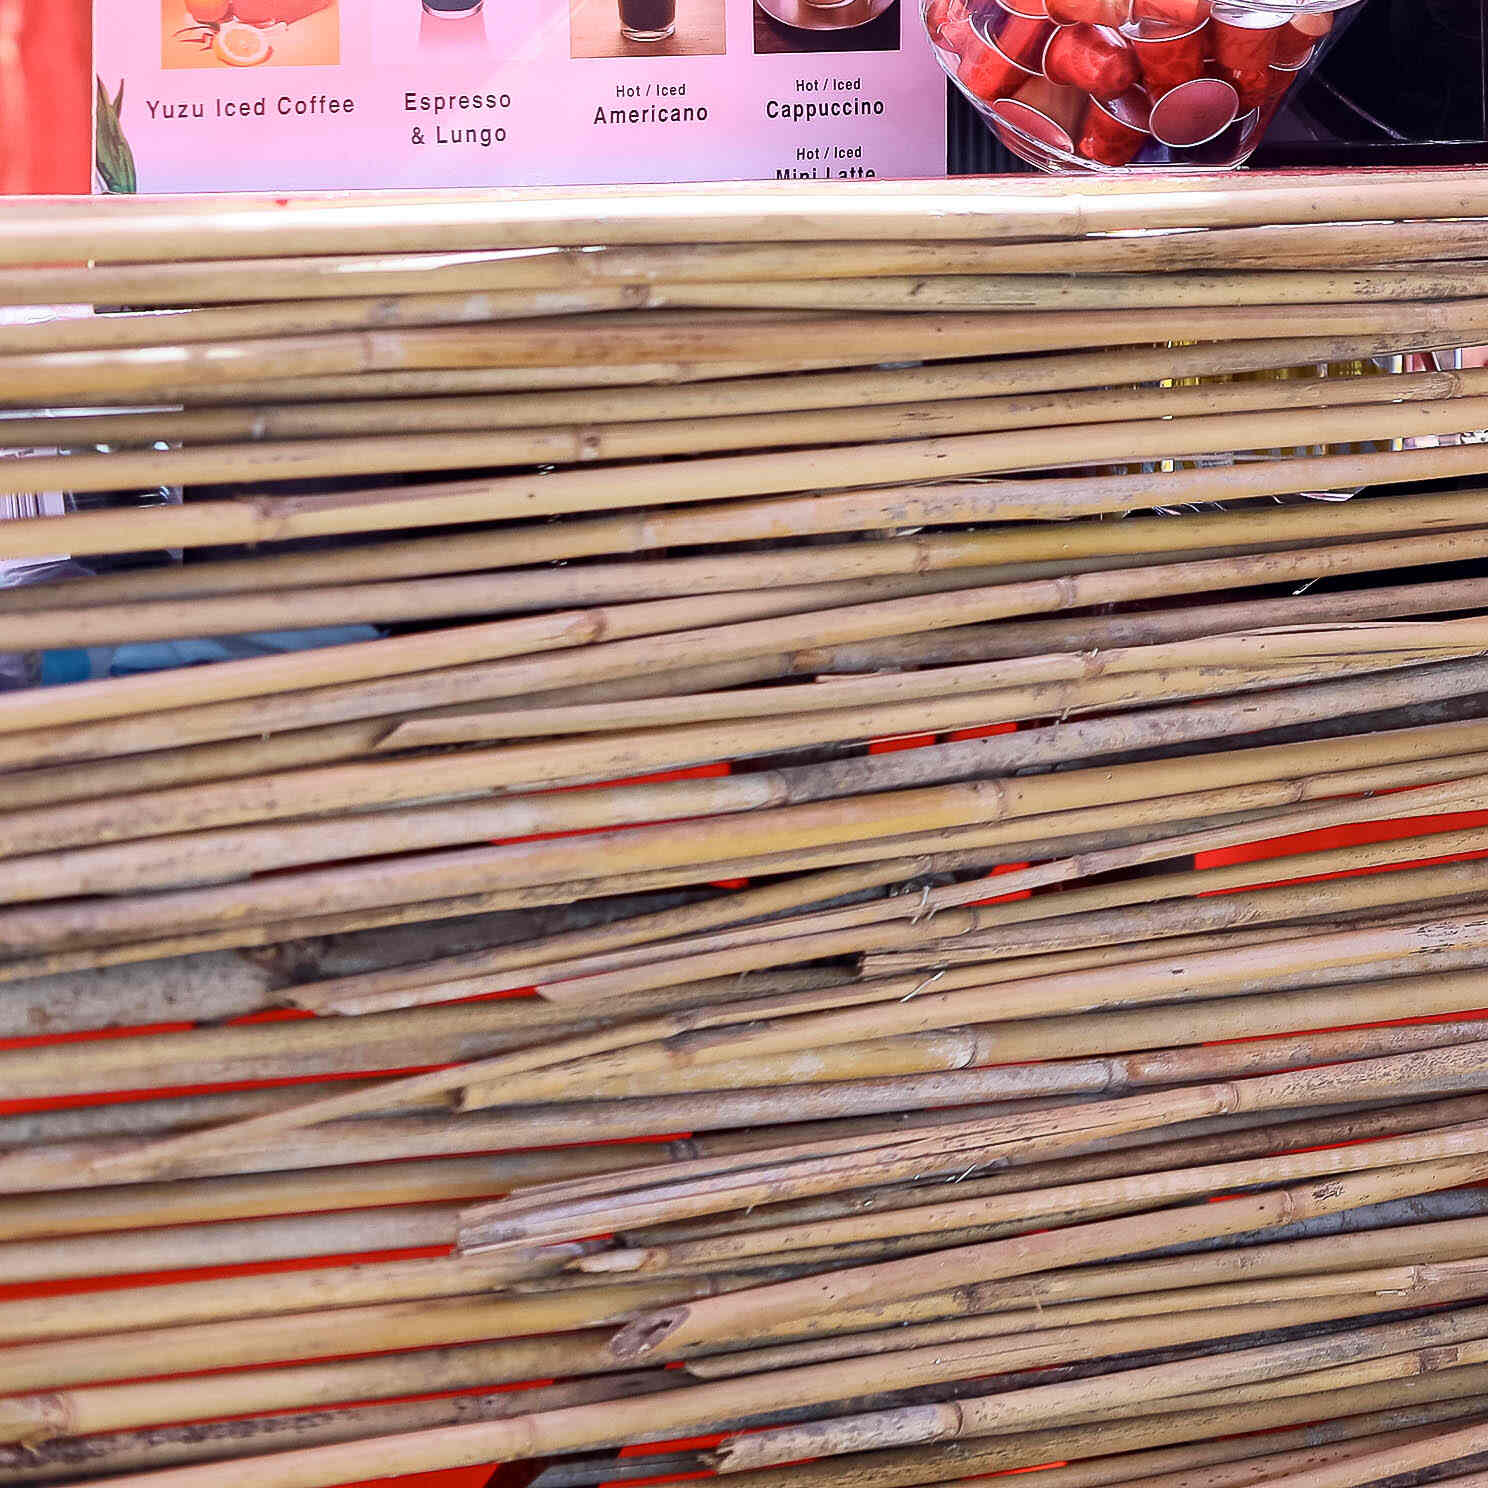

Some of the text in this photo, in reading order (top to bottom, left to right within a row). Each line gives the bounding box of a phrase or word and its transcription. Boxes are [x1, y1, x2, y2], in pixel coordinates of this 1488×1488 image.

[616, 84, 641, 98] Hot
[656, 83, 686, 97] Iced
[796, 79, 819, 92] Hot
[833, 78, 861, 91] Iced
[146, 96, 355, 119] Yuzu Iced Coffee
[404, 92, 511, 114] Espresso
[766, 98, 884, 122] Cappuccino
[593, 104, 707, 125] Americano
[411, 125, 507, 147] & Lungo
[796, 147, 820, 160] Hot
[834, 146, 862, 159] Iced
